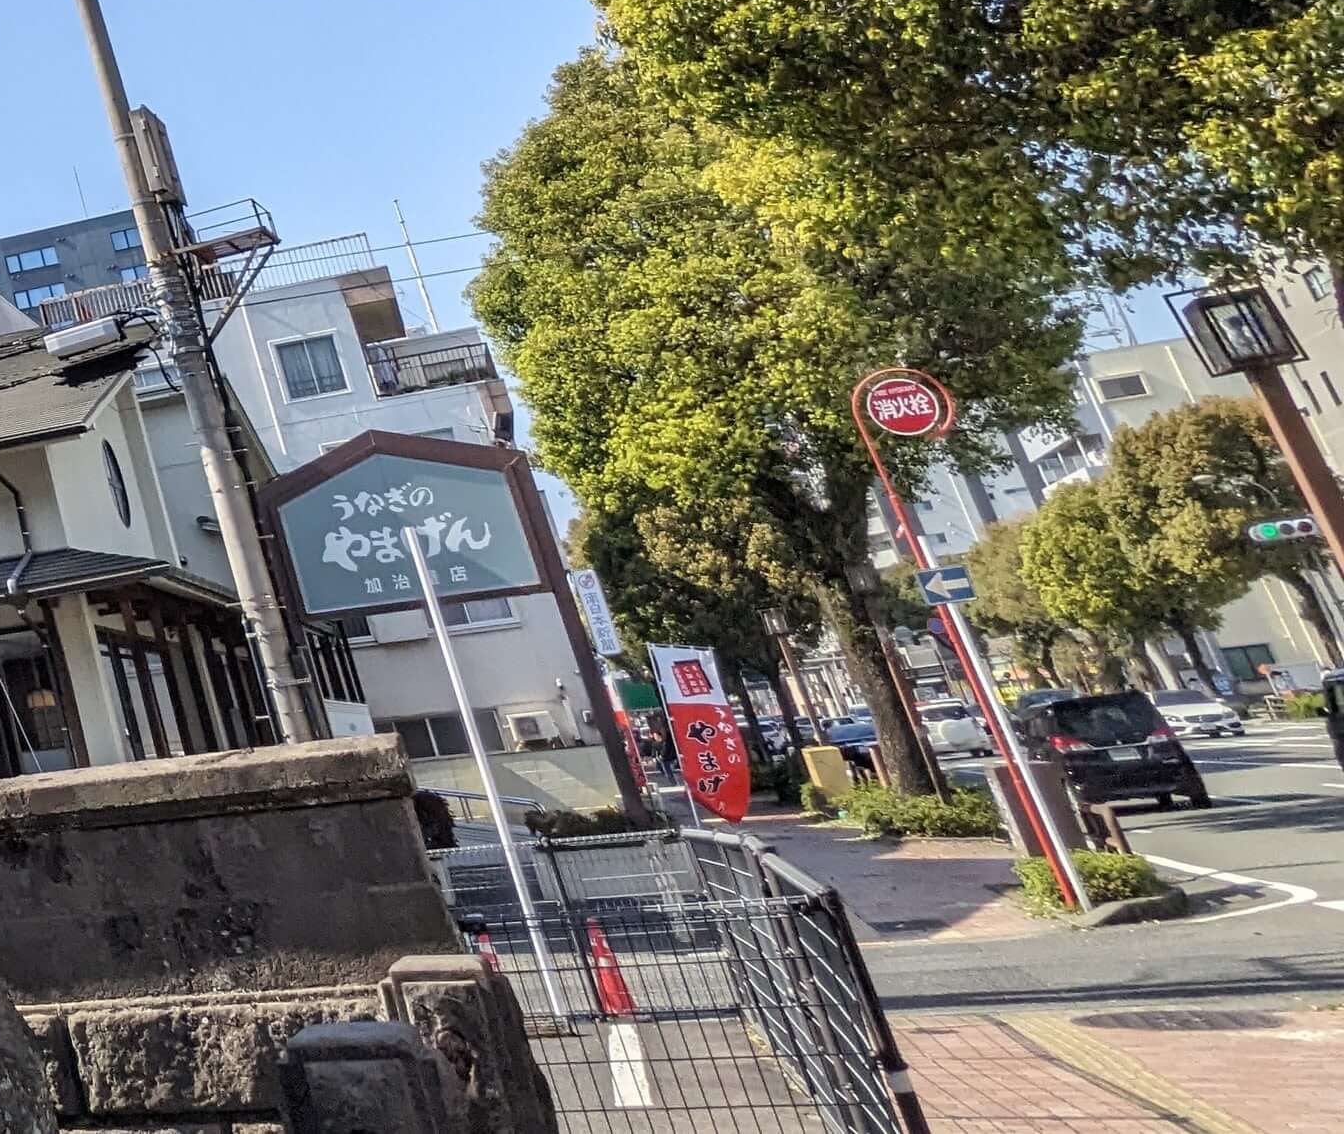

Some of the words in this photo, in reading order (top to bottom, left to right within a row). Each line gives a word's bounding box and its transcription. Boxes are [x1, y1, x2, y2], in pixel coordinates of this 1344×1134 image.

[872, 392, 933, 421] 消火栓
[332, 482, 434, 521] うなぎの
[322, 511, 492, 572] やまげん
[687, 720, 730, 811] やまげ
